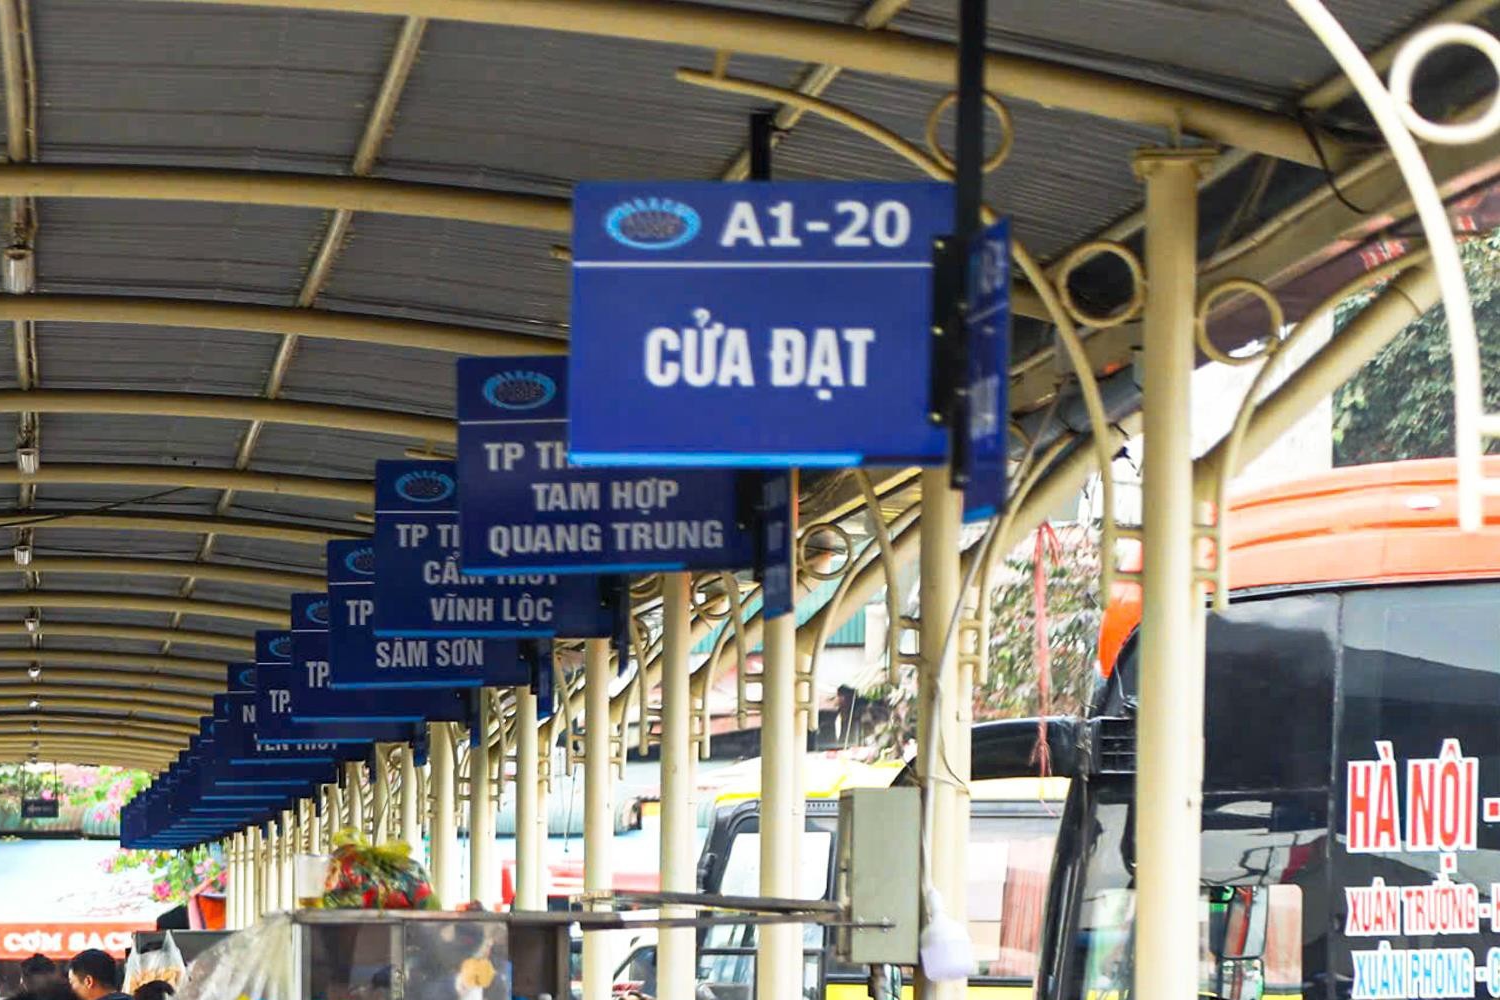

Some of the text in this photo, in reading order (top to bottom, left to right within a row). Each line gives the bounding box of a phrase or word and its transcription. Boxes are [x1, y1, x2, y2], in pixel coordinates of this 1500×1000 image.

[721, 200, 911, 248] A1-20
[643, 307, 875, 401] CỬA ĐẠT
[484, 442, 525, 471] TP
[532, 476, 680, 515] TAM HỢP
[396, 524, 429, 548] TP
[488, 522, 602, 557] QUANG
[611, 519, 725, 550] TRUNG
[346, 599, 375, 626] TP
[430, 591, 553, 627] VĨNH LỘC
[435, 636, 485, 668] SƠN
[1346, 738, 1479, 873] HÀ NỘI
[1345, 873, 1480, 936] XUÂN TRƯỜNG
[1352, 941, 1475, 999] XUÂN PHONG
